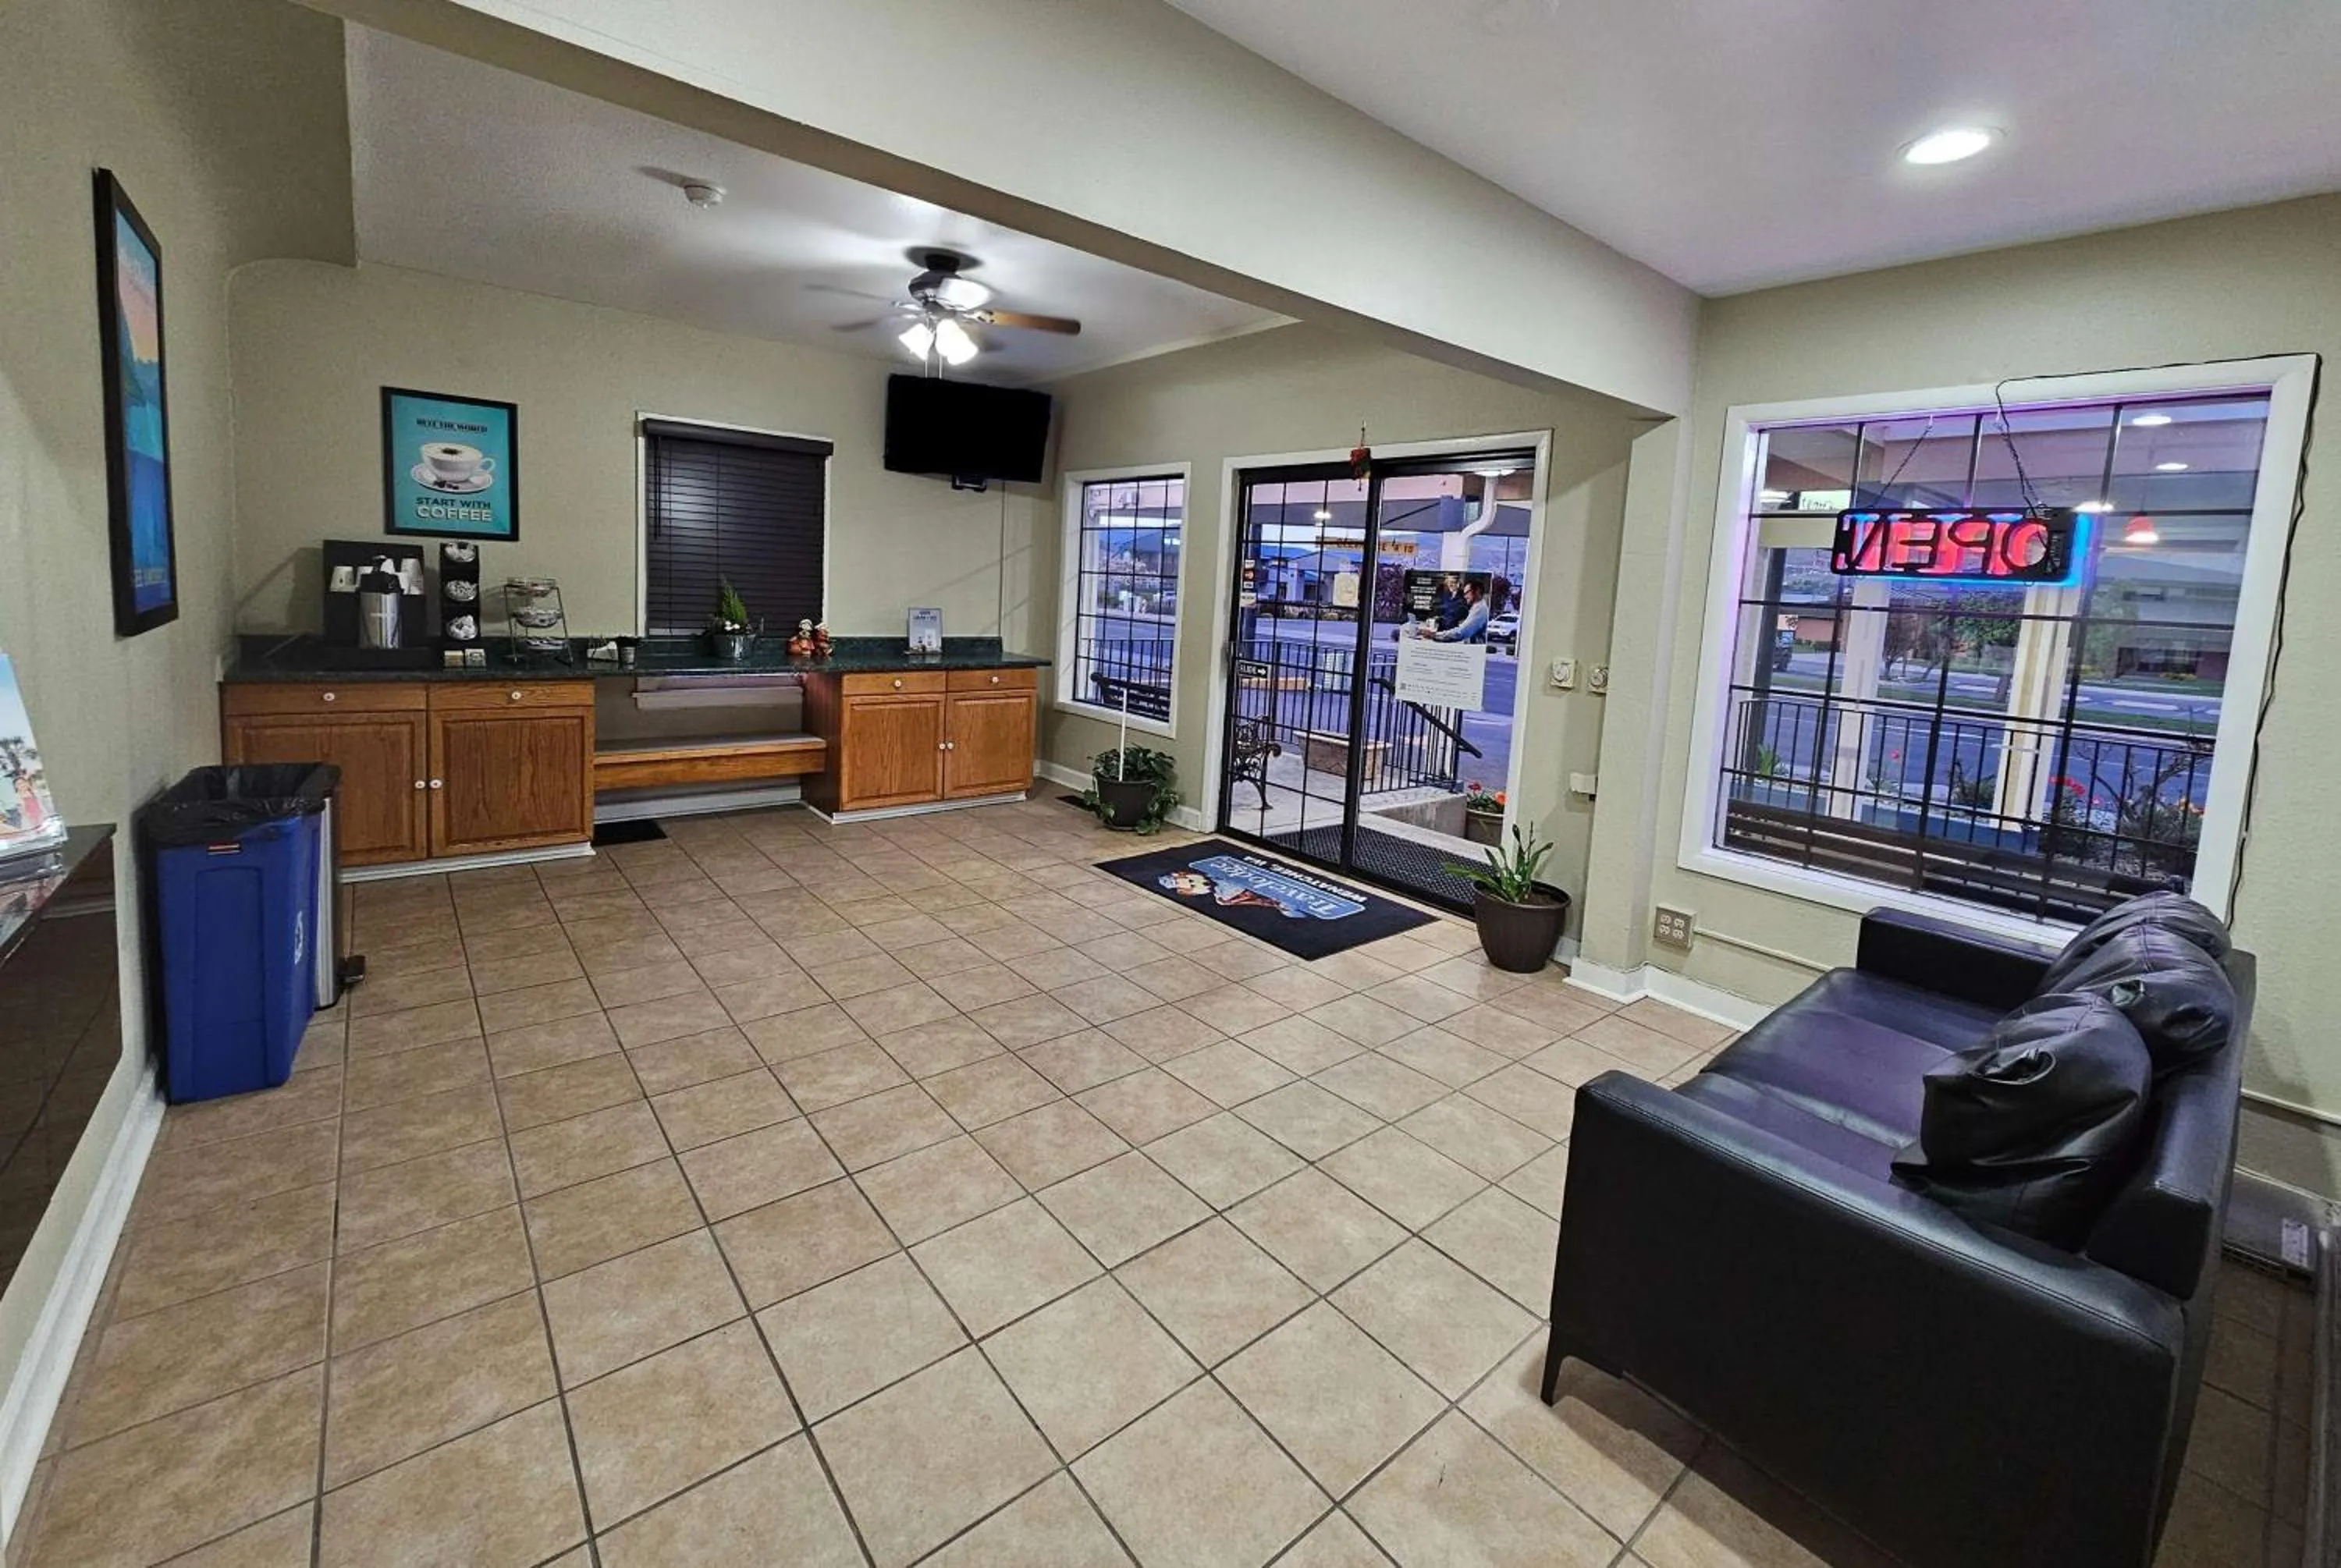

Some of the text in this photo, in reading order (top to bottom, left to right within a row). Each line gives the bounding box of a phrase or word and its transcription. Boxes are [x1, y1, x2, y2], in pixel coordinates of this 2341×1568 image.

[416, 497, 491, 509] START WITH
[416, 506, 492, 522] COFFEE
[1210, 862, 1338, 915] Travelodge
